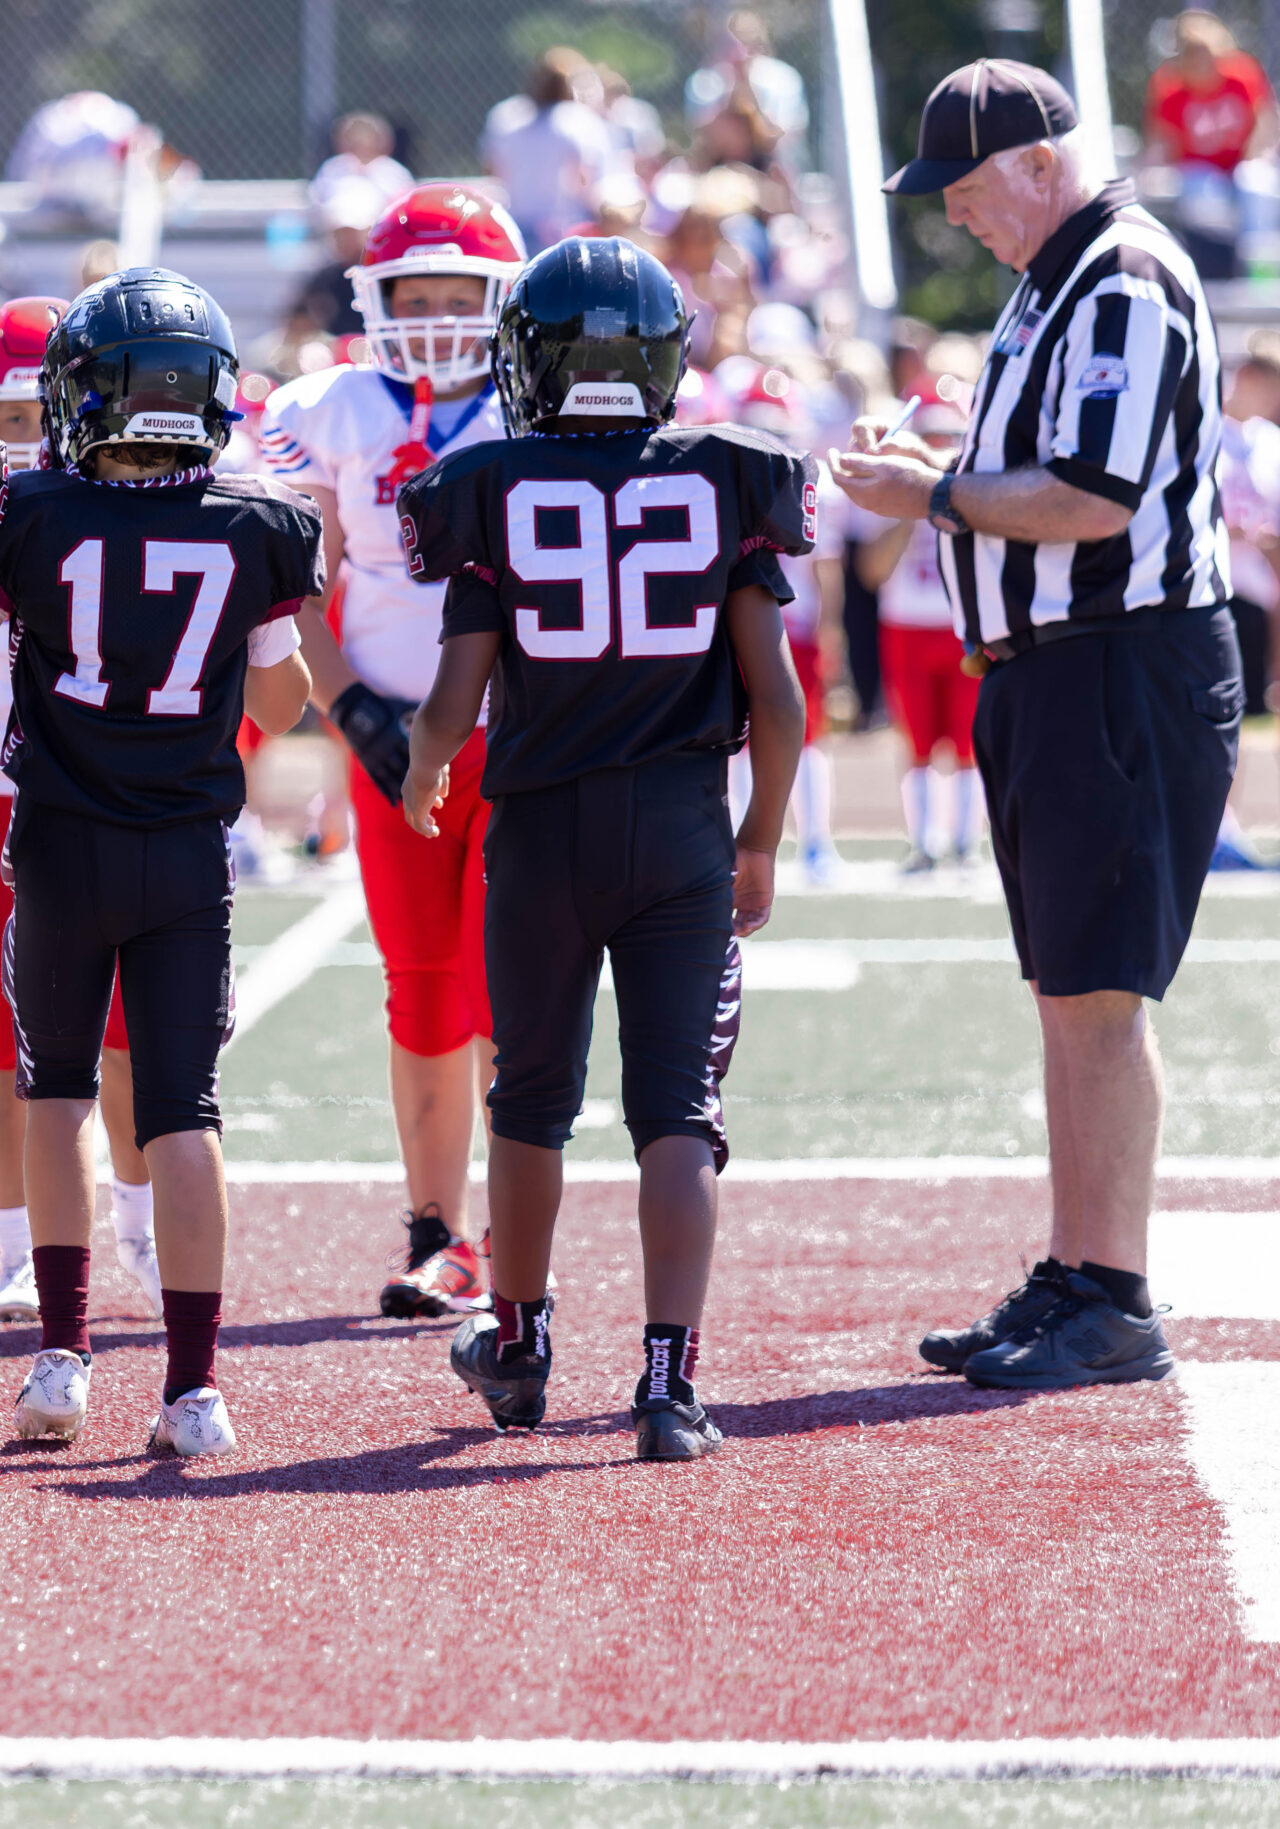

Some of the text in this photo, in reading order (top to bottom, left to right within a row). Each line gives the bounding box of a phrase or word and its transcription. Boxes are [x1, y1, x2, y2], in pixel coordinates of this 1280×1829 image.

[142, 417, 195, 430] MUDHOGS
[574, 395, 634, 406] MUDHOGS
[504, 472, 721, 661] 92
[51, 537, 239, 717] 17
